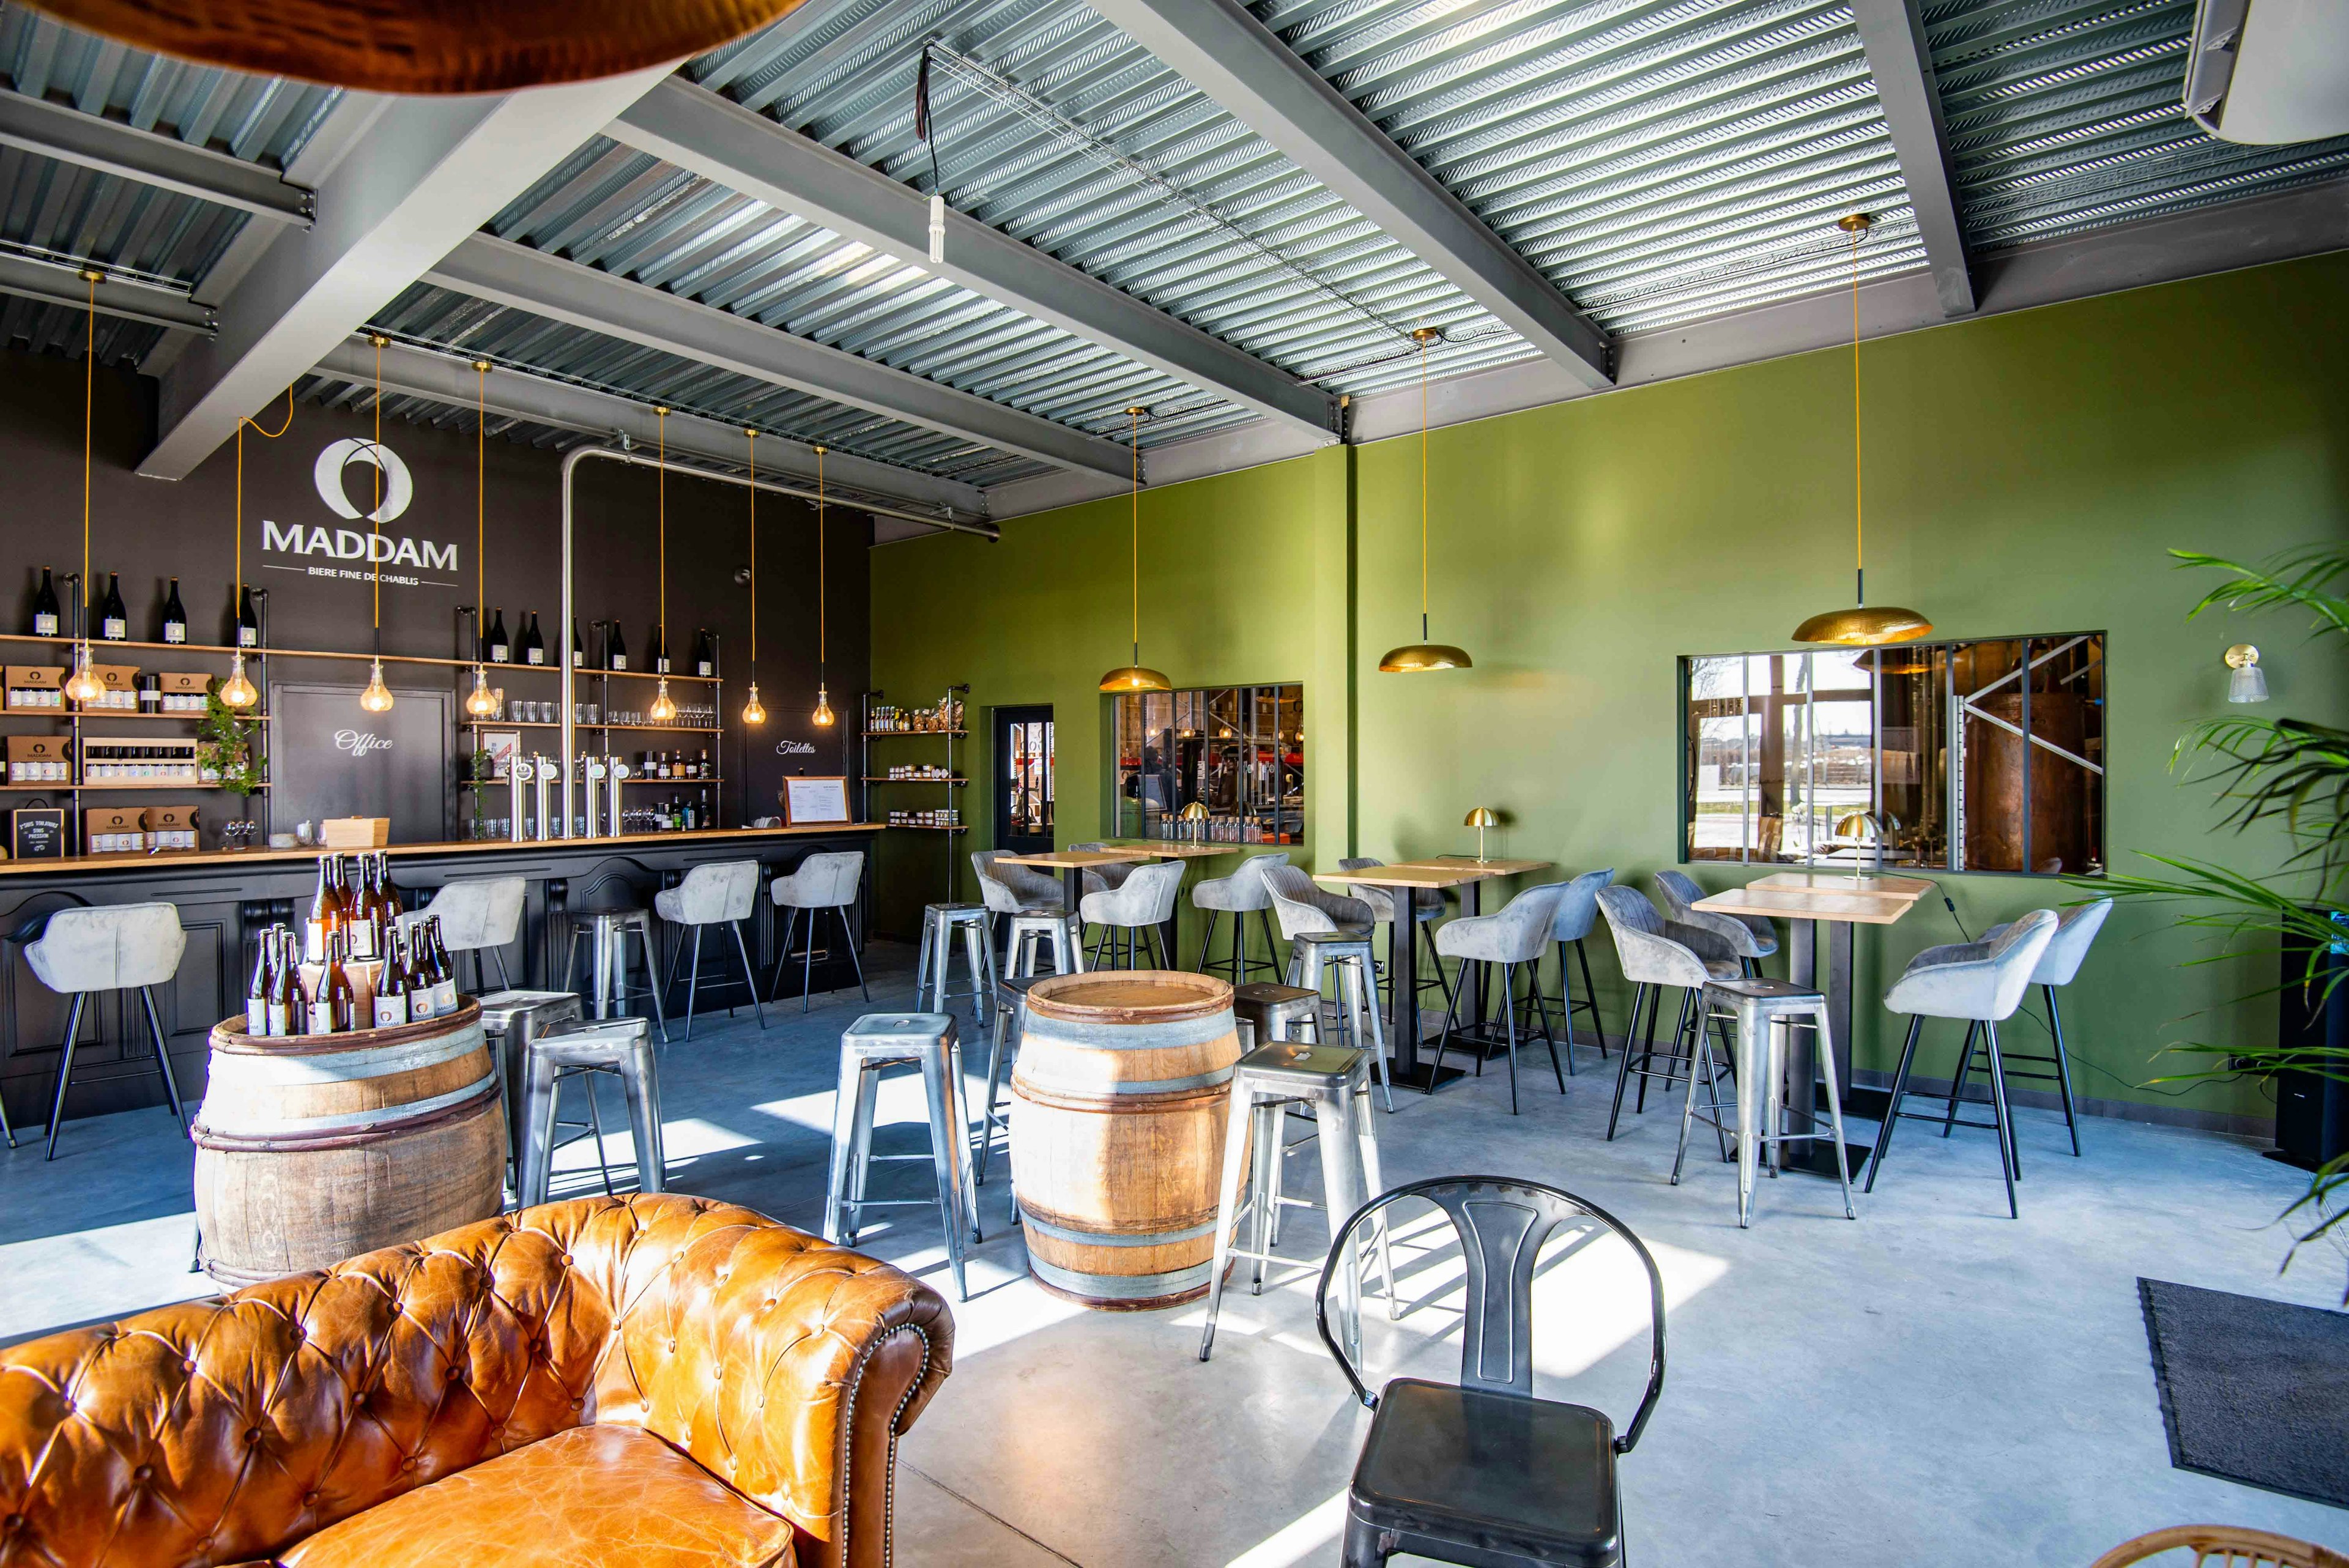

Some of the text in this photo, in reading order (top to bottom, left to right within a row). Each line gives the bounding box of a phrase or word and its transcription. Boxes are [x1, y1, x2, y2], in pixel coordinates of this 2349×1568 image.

[262, 519, 458, 571] MADDAM
[308, 567, 419, 585] BIERE FINE DE CHABLIS
[335, 729, 393, 756] Office
[776, 740, 816, 754] Toilettes
